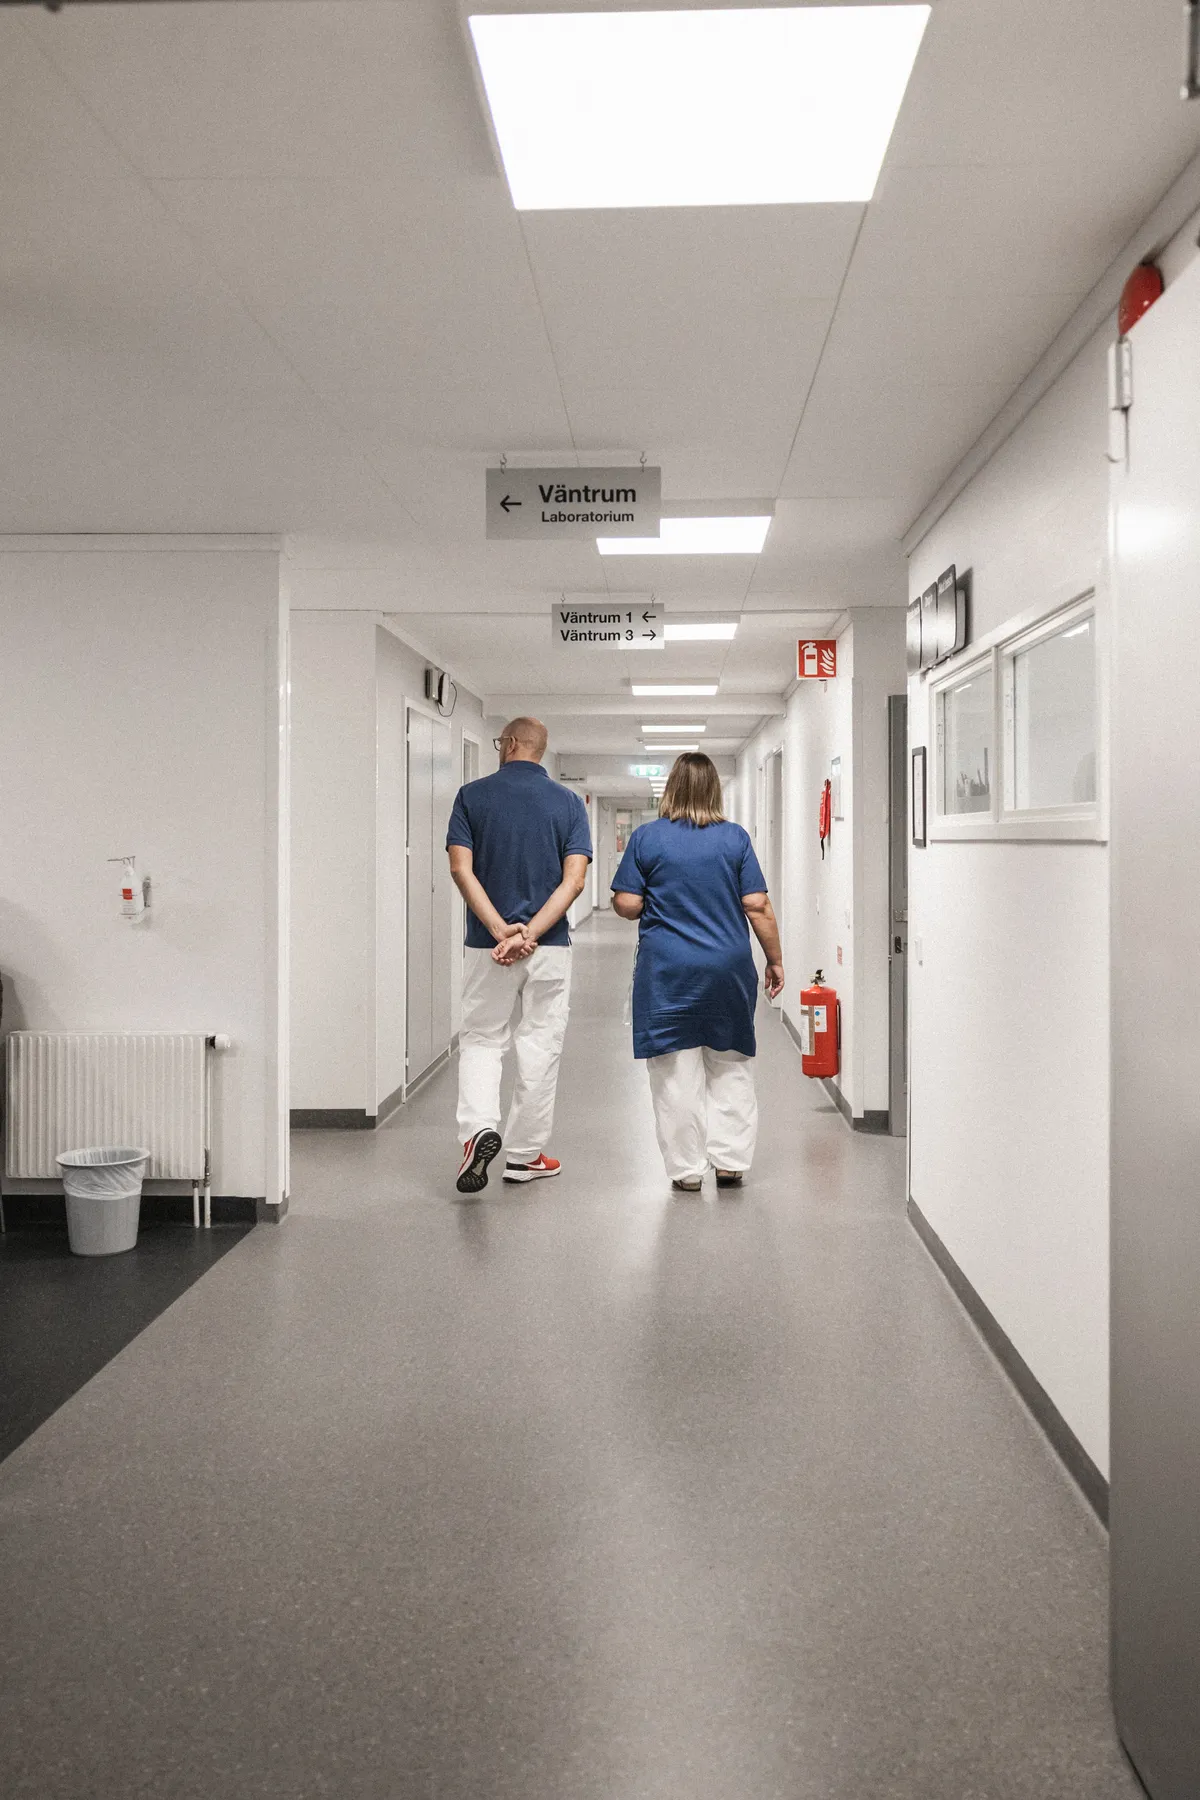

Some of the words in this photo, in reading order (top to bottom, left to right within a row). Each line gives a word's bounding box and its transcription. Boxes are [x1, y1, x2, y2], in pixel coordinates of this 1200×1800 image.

[538, 484, 637, 503] Väntrum
[541, 510, 635, 523] Laboratorium
[560, 611, 621, 624] Väntrum
[625, 611, 633, 623] 1
[560, 629, 621, 642] Väntrum
[625, 629, 634, 641] 3
